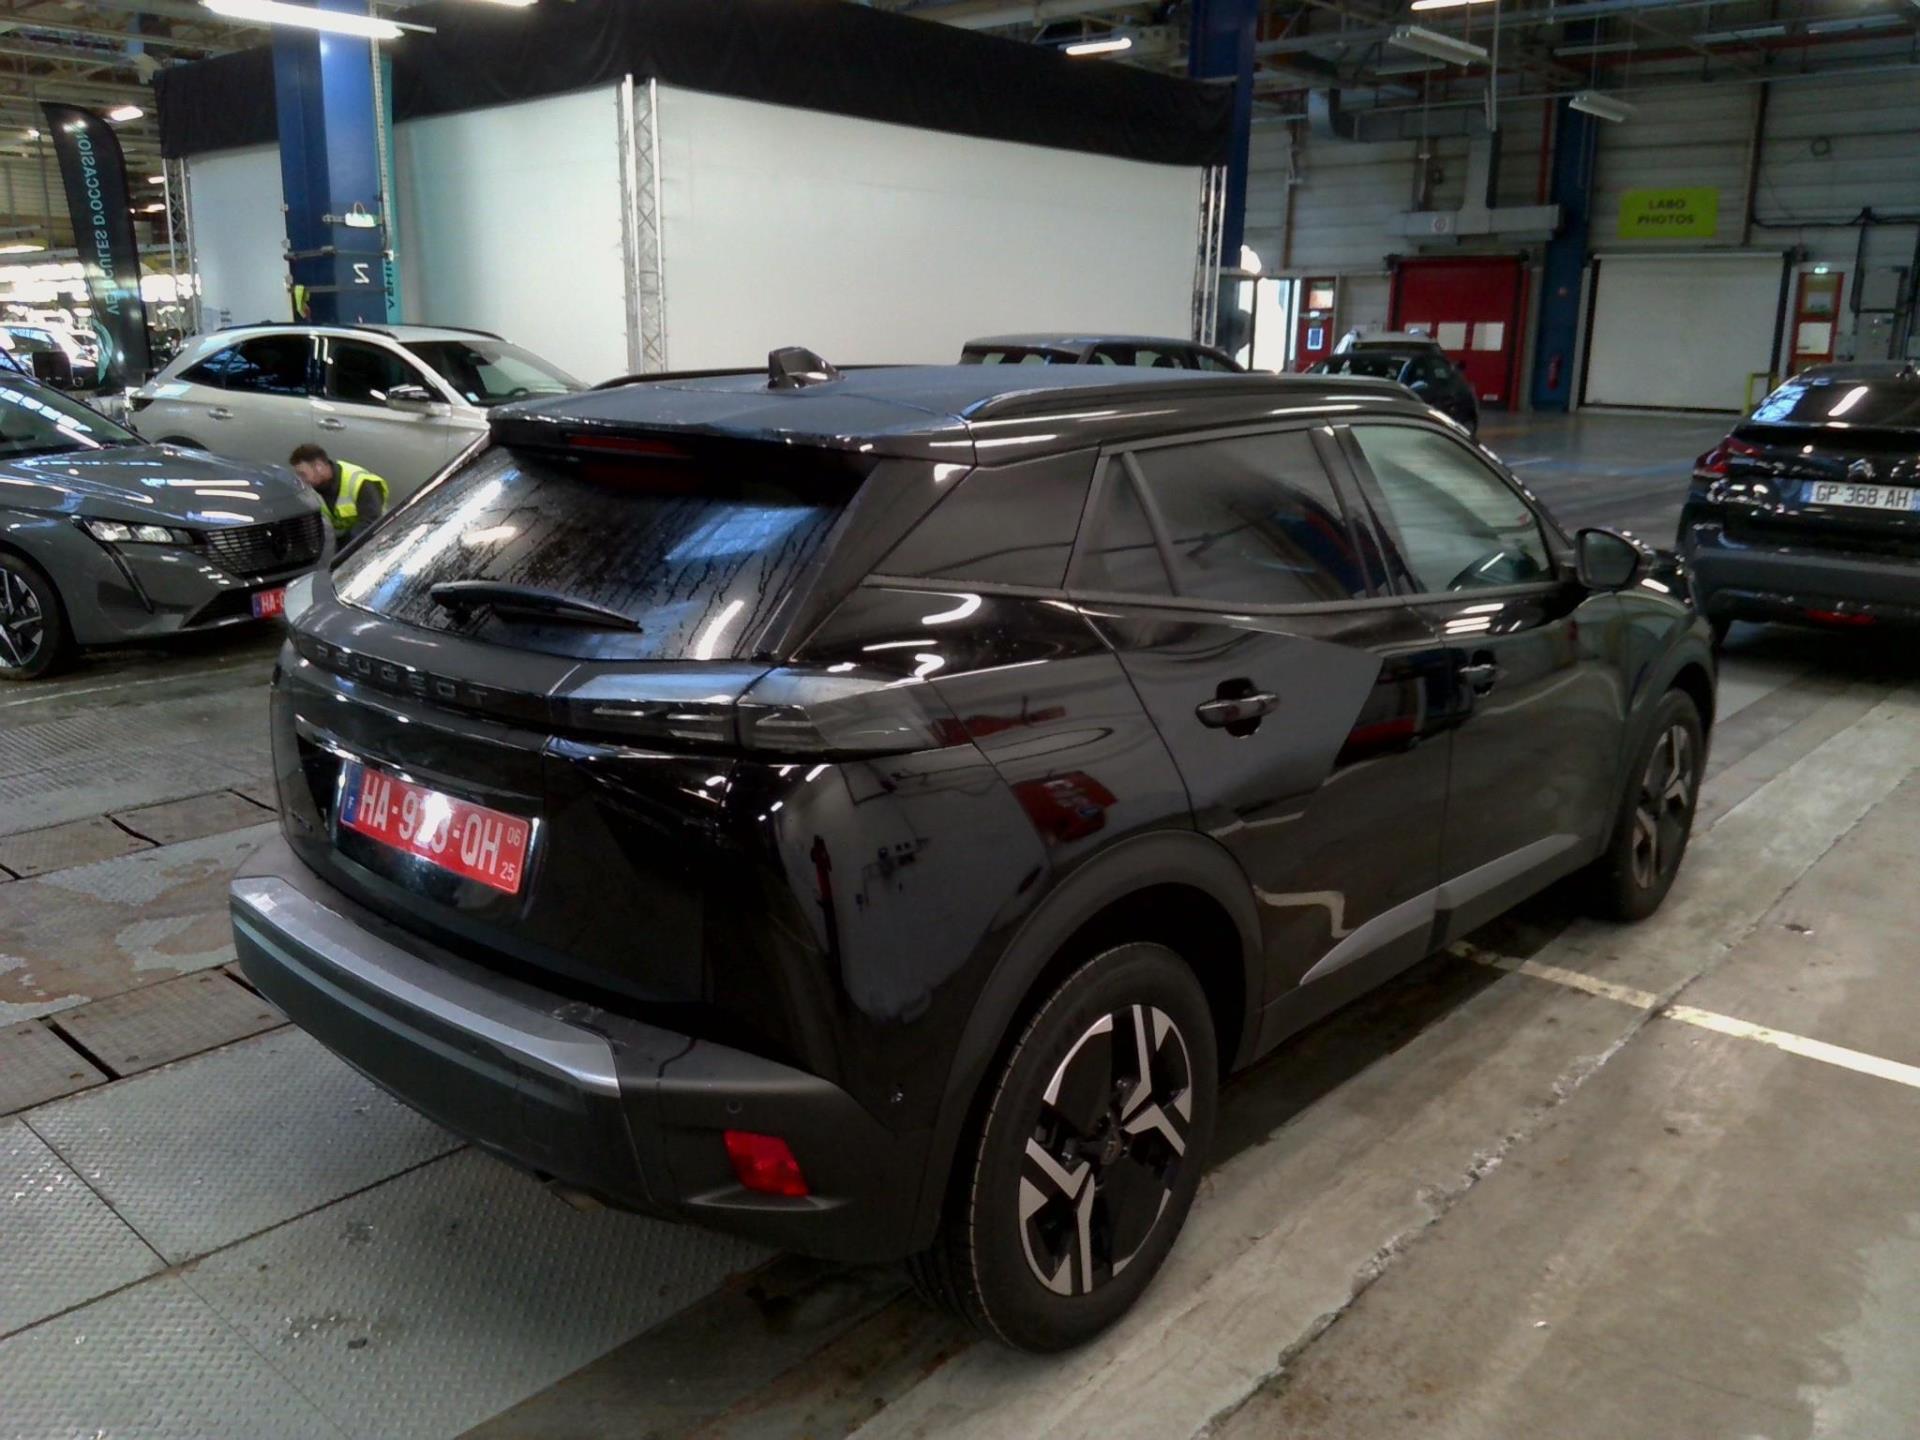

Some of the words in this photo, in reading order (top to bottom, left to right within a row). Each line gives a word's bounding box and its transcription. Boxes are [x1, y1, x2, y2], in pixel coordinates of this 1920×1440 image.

[1648, 199, 1686, 210] LABO
[1637, 213, 1695, 225] PHOTOS
[1816, 483, 1909, 508] GP-368-AH
[315, 643, 488, 703] PEUGEOT
[359, 772, 504, 876] HA-9-QH
[507, 826, 522, 848] 06
[500, 861, 516, 882] 25
